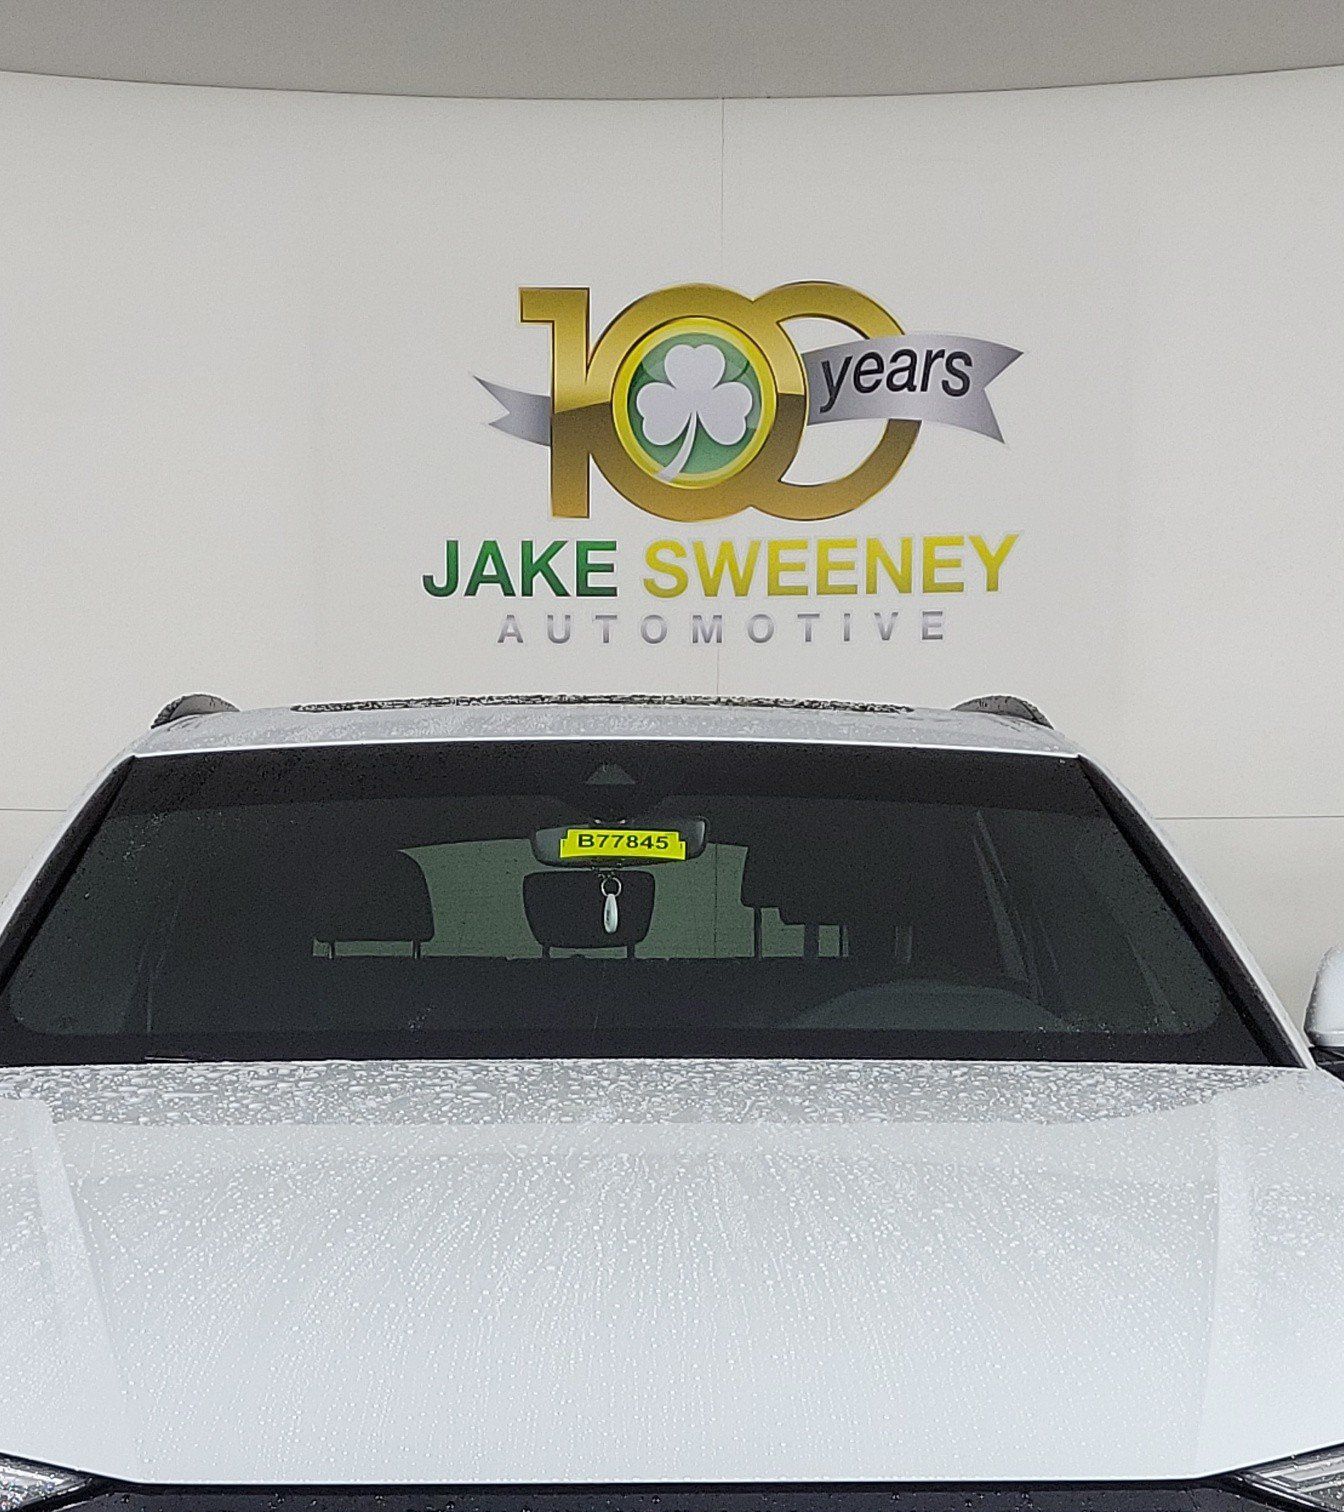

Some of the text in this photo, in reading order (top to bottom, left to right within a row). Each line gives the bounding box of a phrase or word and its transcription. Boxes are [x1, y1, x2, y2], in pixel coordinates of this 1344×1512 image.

[518, 280, 973, 523] 100 years
[422, 534, 1019, 598] JAKE SWEENEY
[497, 611, 944, 645] AUTOMOTIVE
[578, 833, 669, 849] B77845
